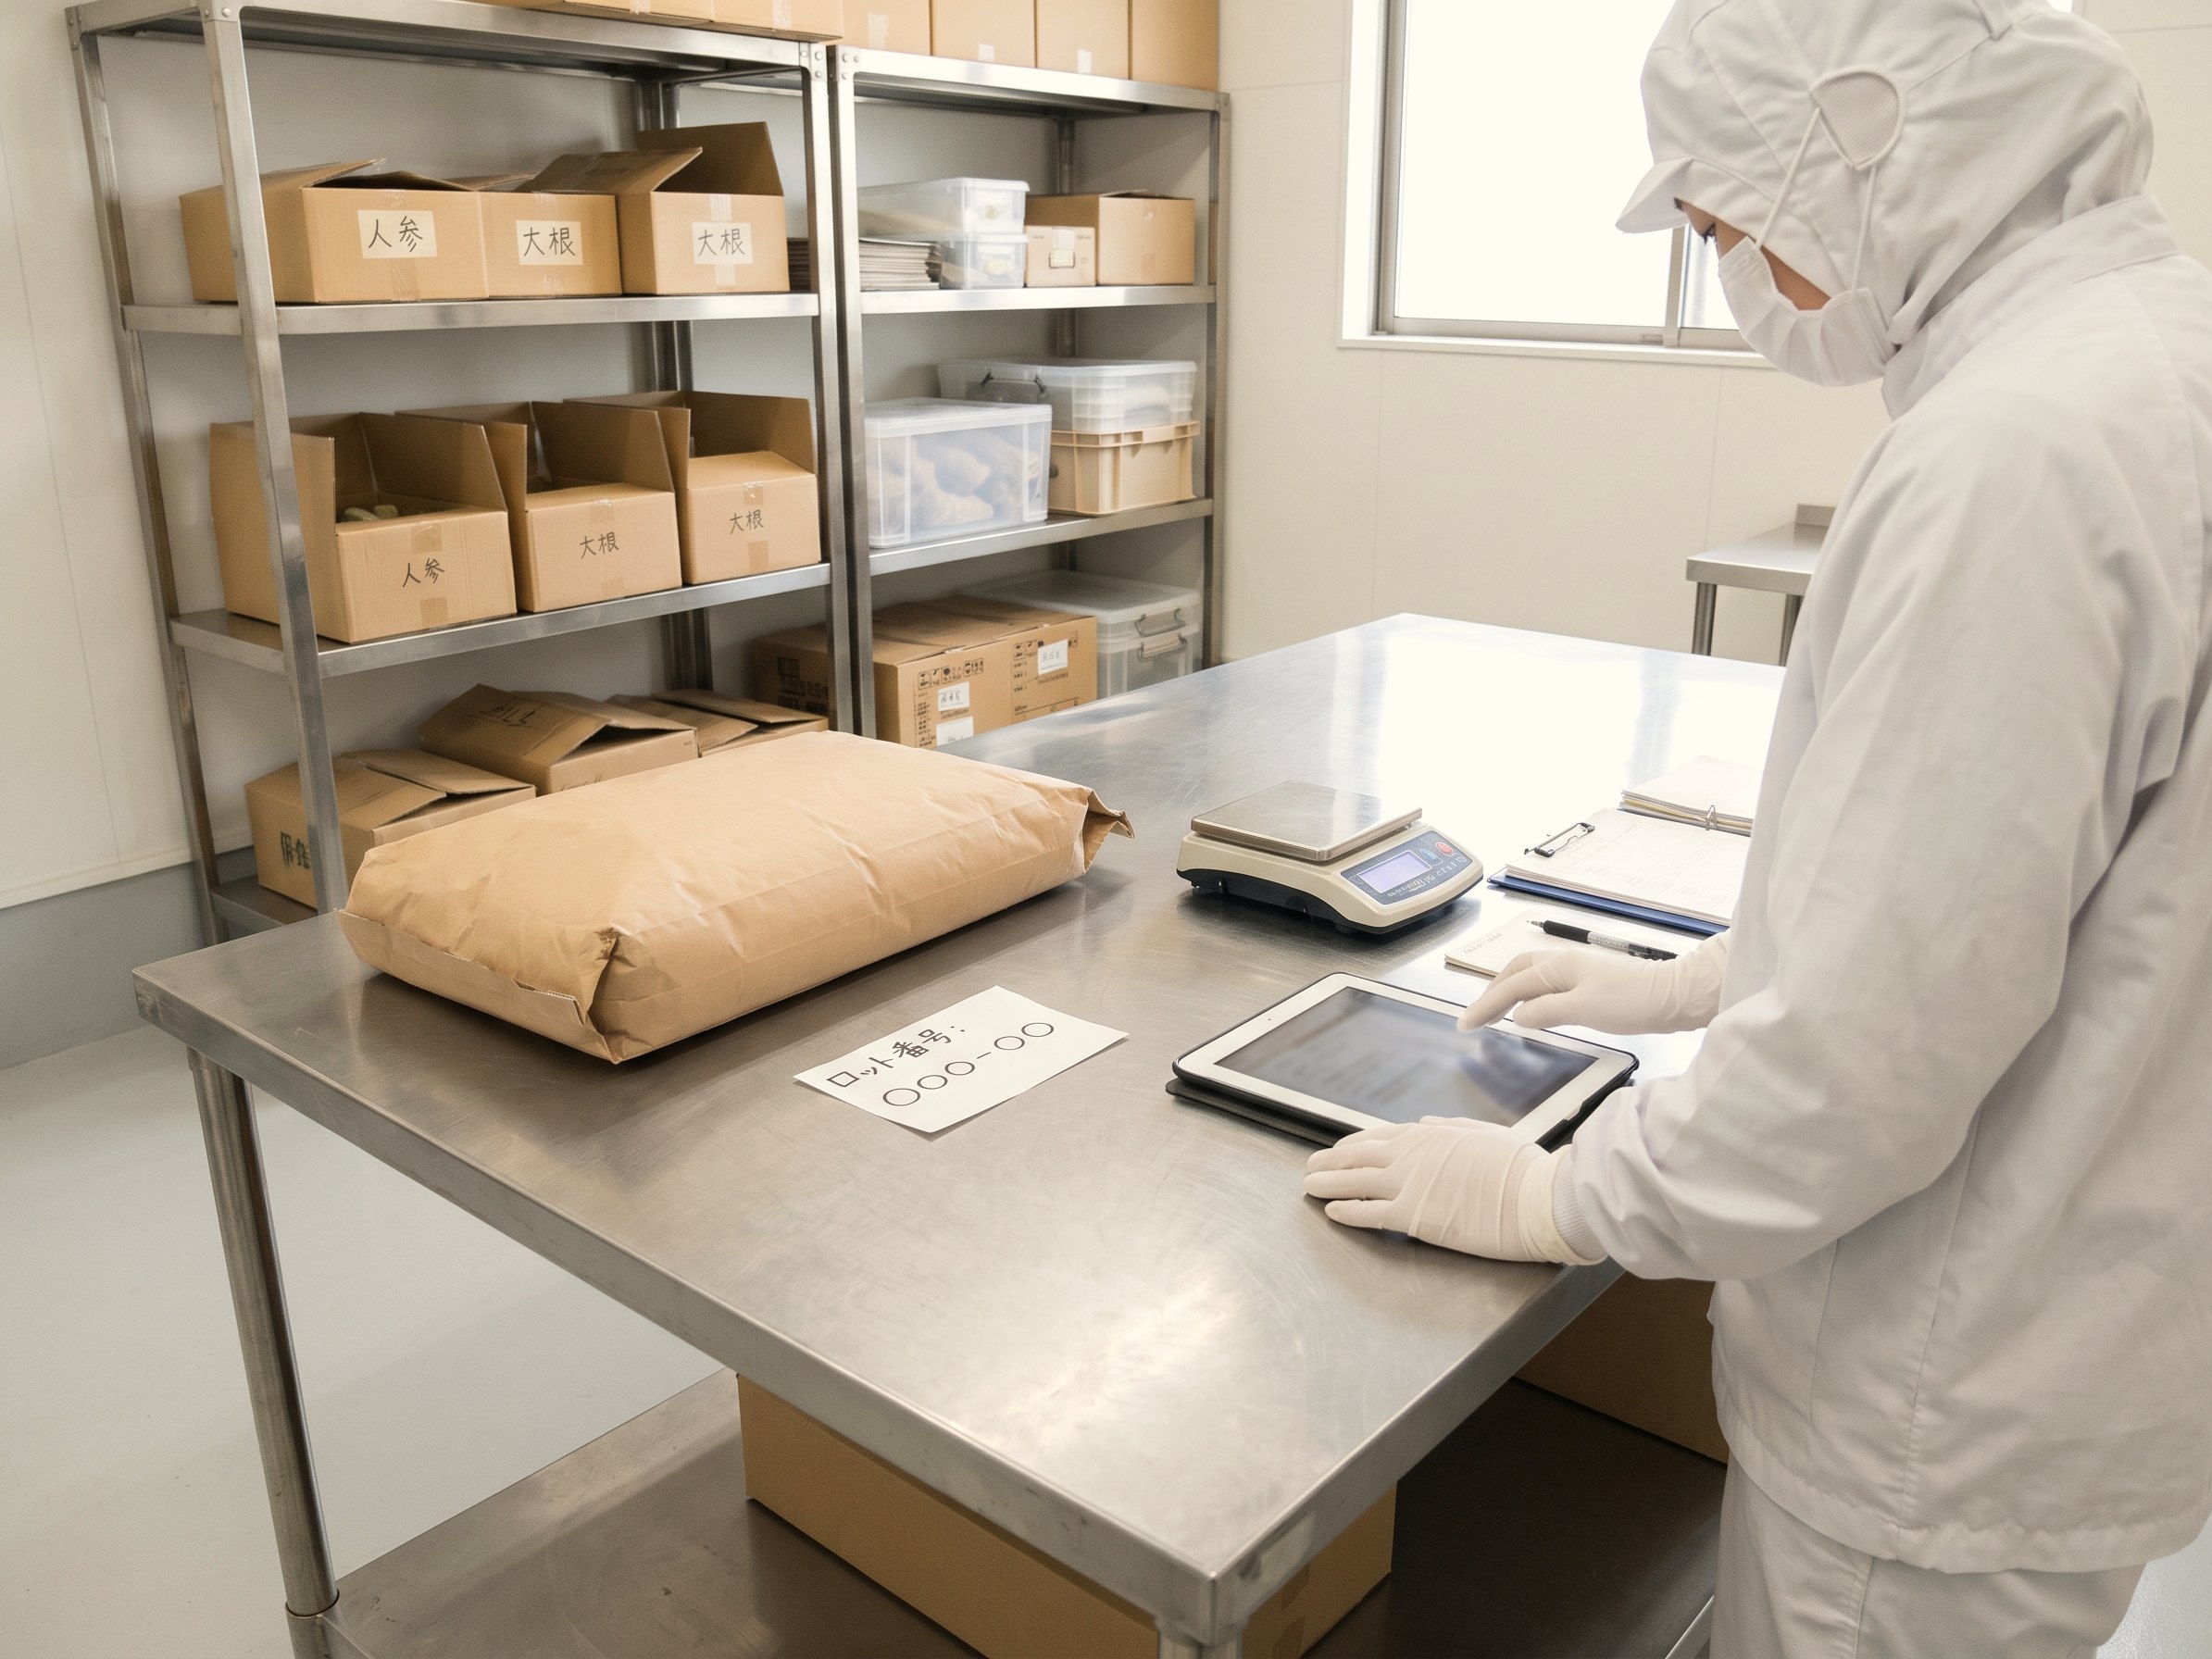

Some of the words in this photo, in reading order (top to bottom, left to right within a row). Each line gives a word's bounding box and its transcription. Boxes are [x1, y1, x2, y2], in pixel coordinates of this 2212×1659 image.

[368, 215, 424, 253] 人参
[522, 226, 576, 257] 大根
[697, 228, 745, 256] 大根
[729, 509, 764, 535] 大根
[579, 531, 619, 559] 大根
[402, 557, 445, 589] 人参
[826, 1025, 966, 1088] ロット番号:
